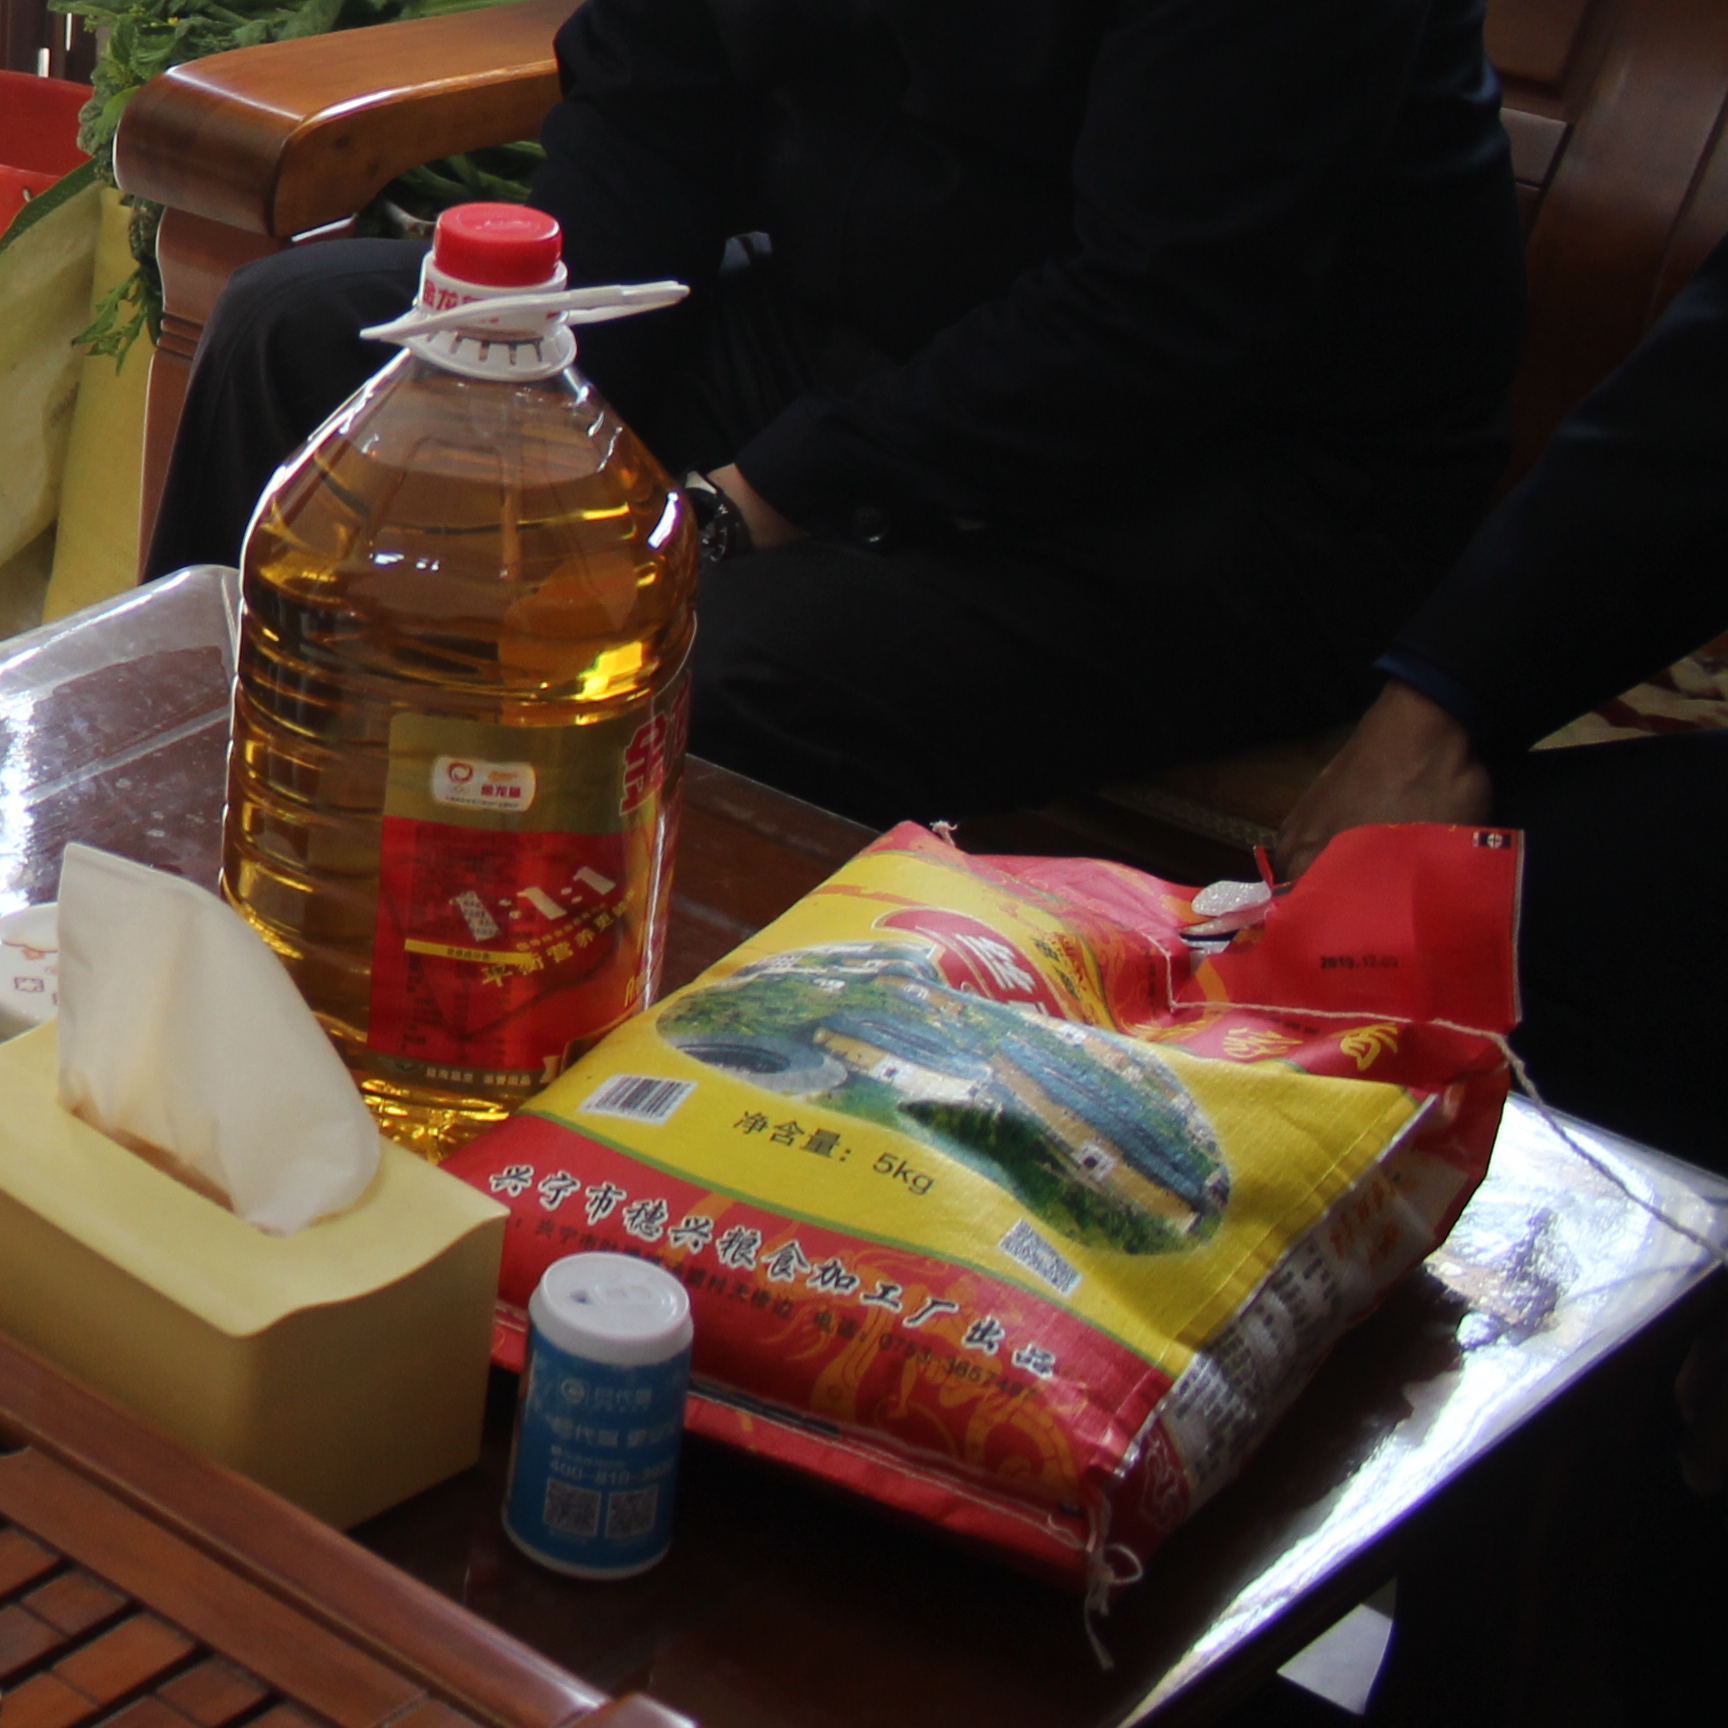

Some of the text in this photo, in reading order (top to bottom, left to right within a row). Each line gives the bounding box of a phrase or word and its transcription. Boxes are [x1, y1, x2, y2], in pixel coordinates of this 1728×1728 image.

[449, 866, 616, 942] 1:1:1
[733, 1110, 935, 1195] 净含量： 5kg
[489, 1164, 1057, 1380] 兴宁市穗兴粮食加工厂出品
